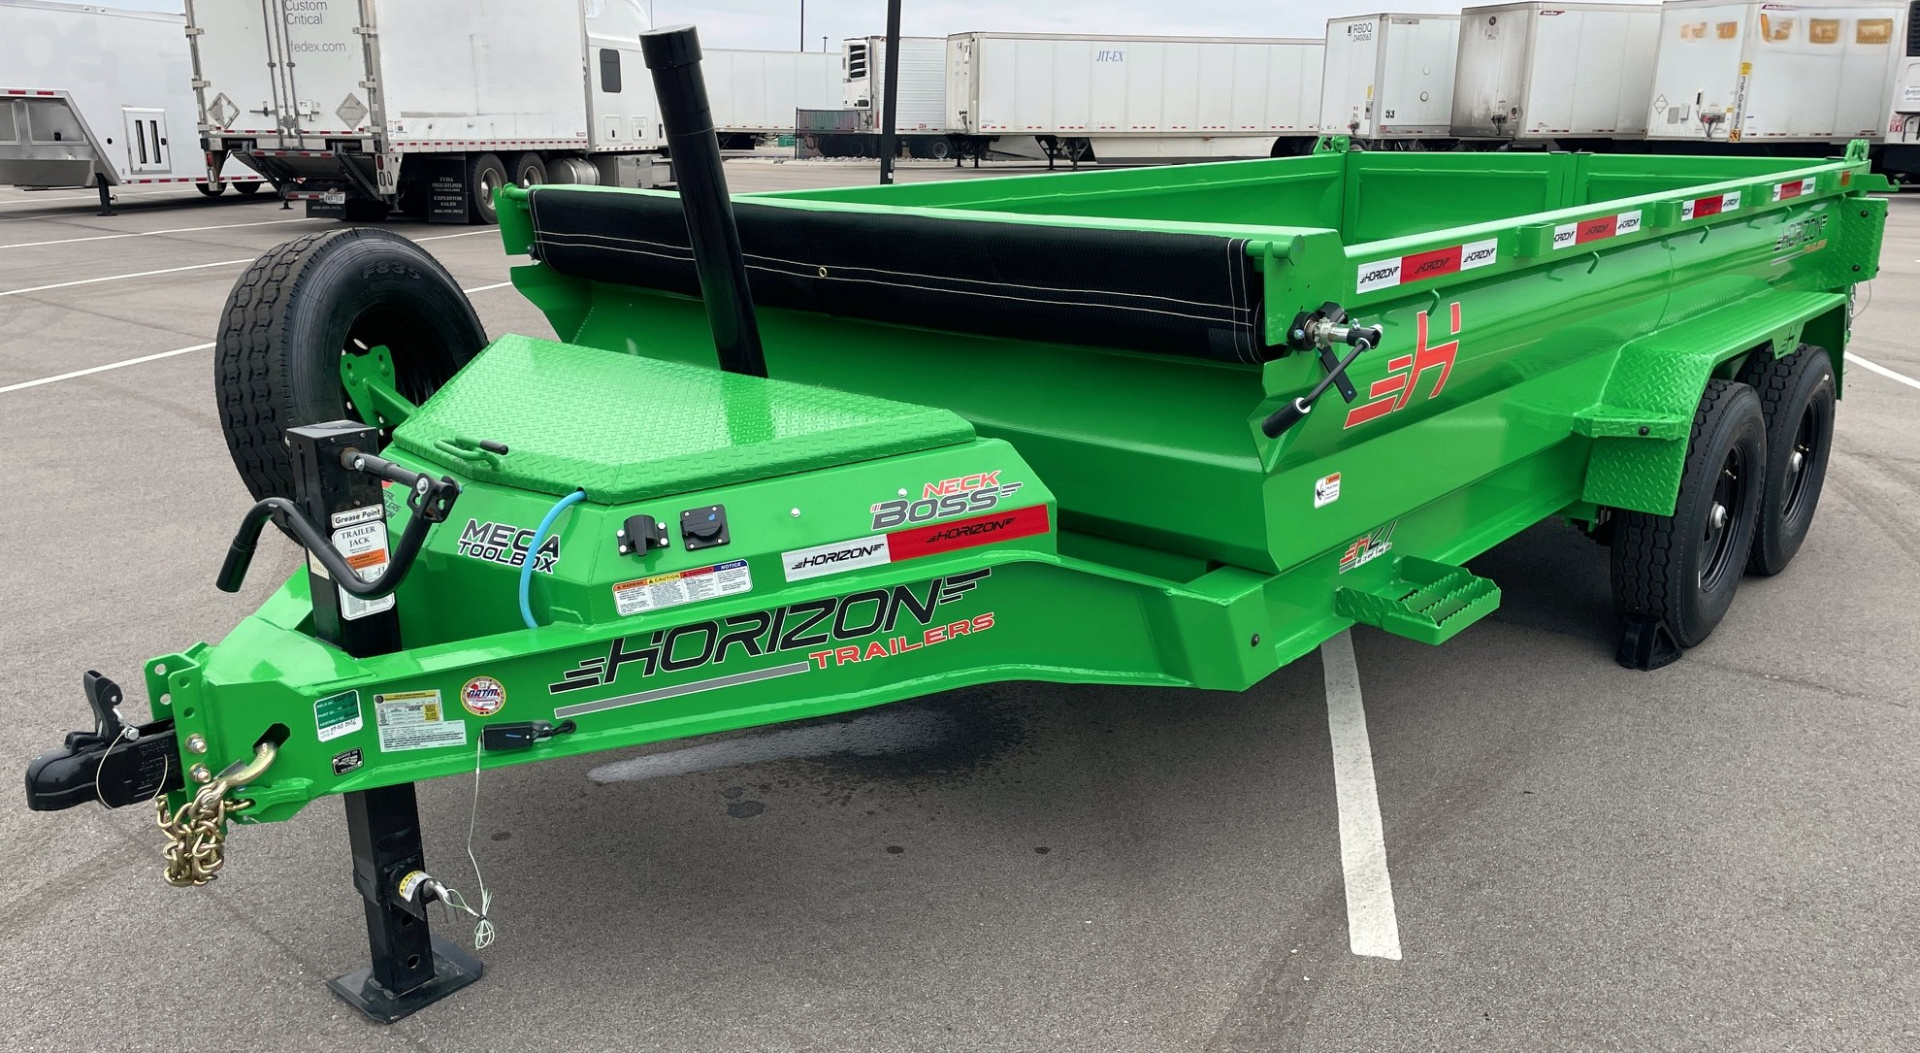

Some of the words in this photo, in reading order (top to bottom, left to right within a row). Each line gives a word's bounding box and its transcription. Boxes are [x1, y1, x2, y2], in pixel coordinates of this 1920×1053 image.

[285, 0, 327, 11] Custom
[286, 13, 322, 25] Critical
[1353, 22, 1373, 34] RBDQ
[290, 41, 346, 52] fedex.com
[1096, 50, 1125, 62] JIT-EX
[1465, 248, 1495, 263] HORIZON
[363, 260, 421, 279] F835
[1362, 267, 1398, 283] HORIZON
[922, 469, 1001, 499] NECK
[871, 486, 1001, 531] BOSS
[335, 513, 360, 525] Grease
[362, 508, 381, 519] Point
[341, 525, 376, 540] TRAILER
[932, 518, 1011, 542] HORIZON
[349, 536, 370, 548] JACK
[797, 544, 880, 569] HORIZON
[720, 562, 742, 570] NOTICE
[654, 573, 680, 583] CAUTION
[582, 572, 965, 689] HORIZON
[809, 612, 996, 670] TRAILERS
